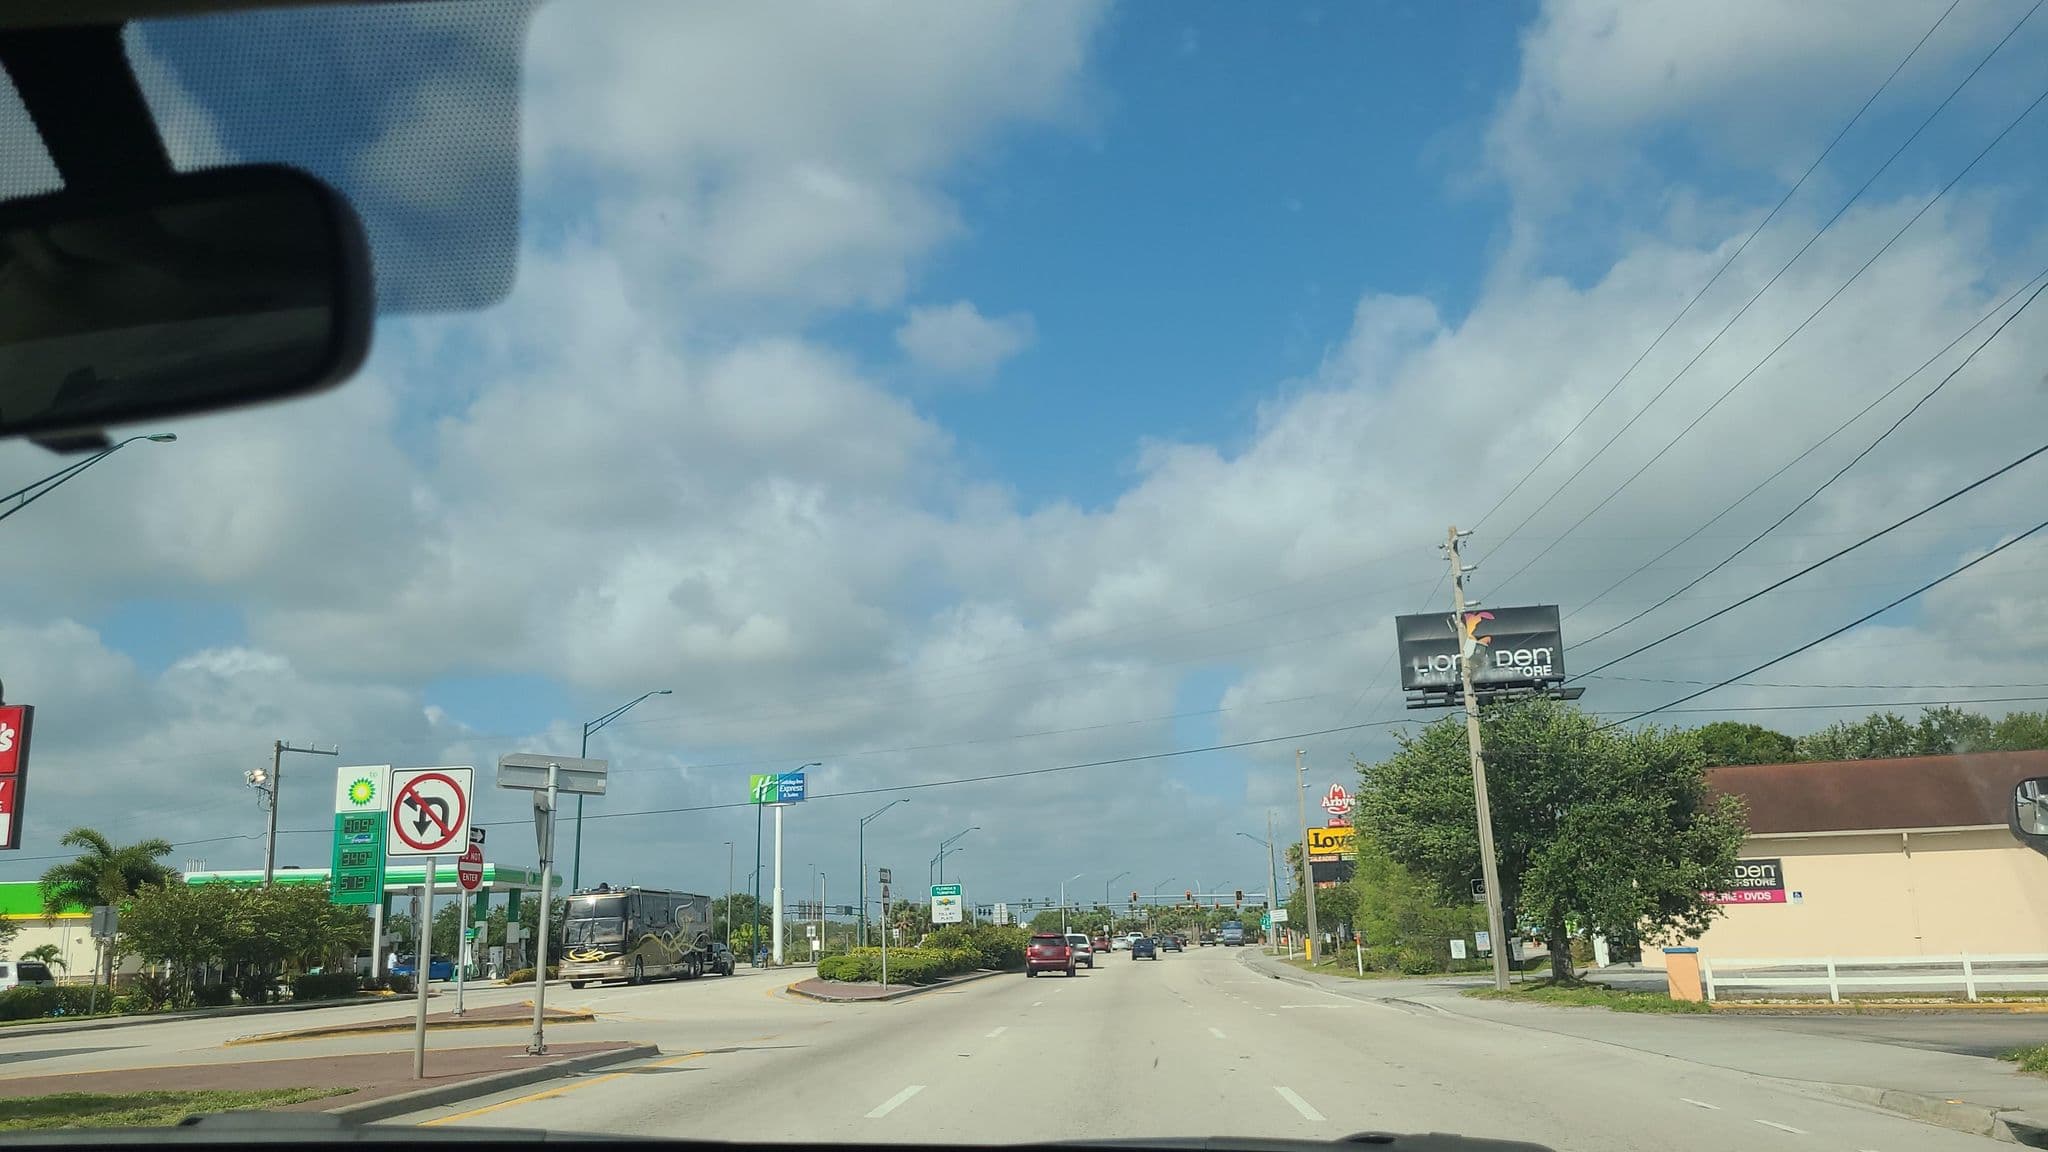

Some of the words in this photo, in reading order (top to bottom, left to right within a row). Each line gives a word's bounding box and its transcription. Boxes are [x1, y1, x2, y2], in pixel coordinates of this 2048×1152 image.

[1321, 794, 1356, 809] Arby's
[1734, 865, 1775, 878] Den
[462, 873, 478, 882] ENTER
[1743, 891, 1771, 900] DVDS
